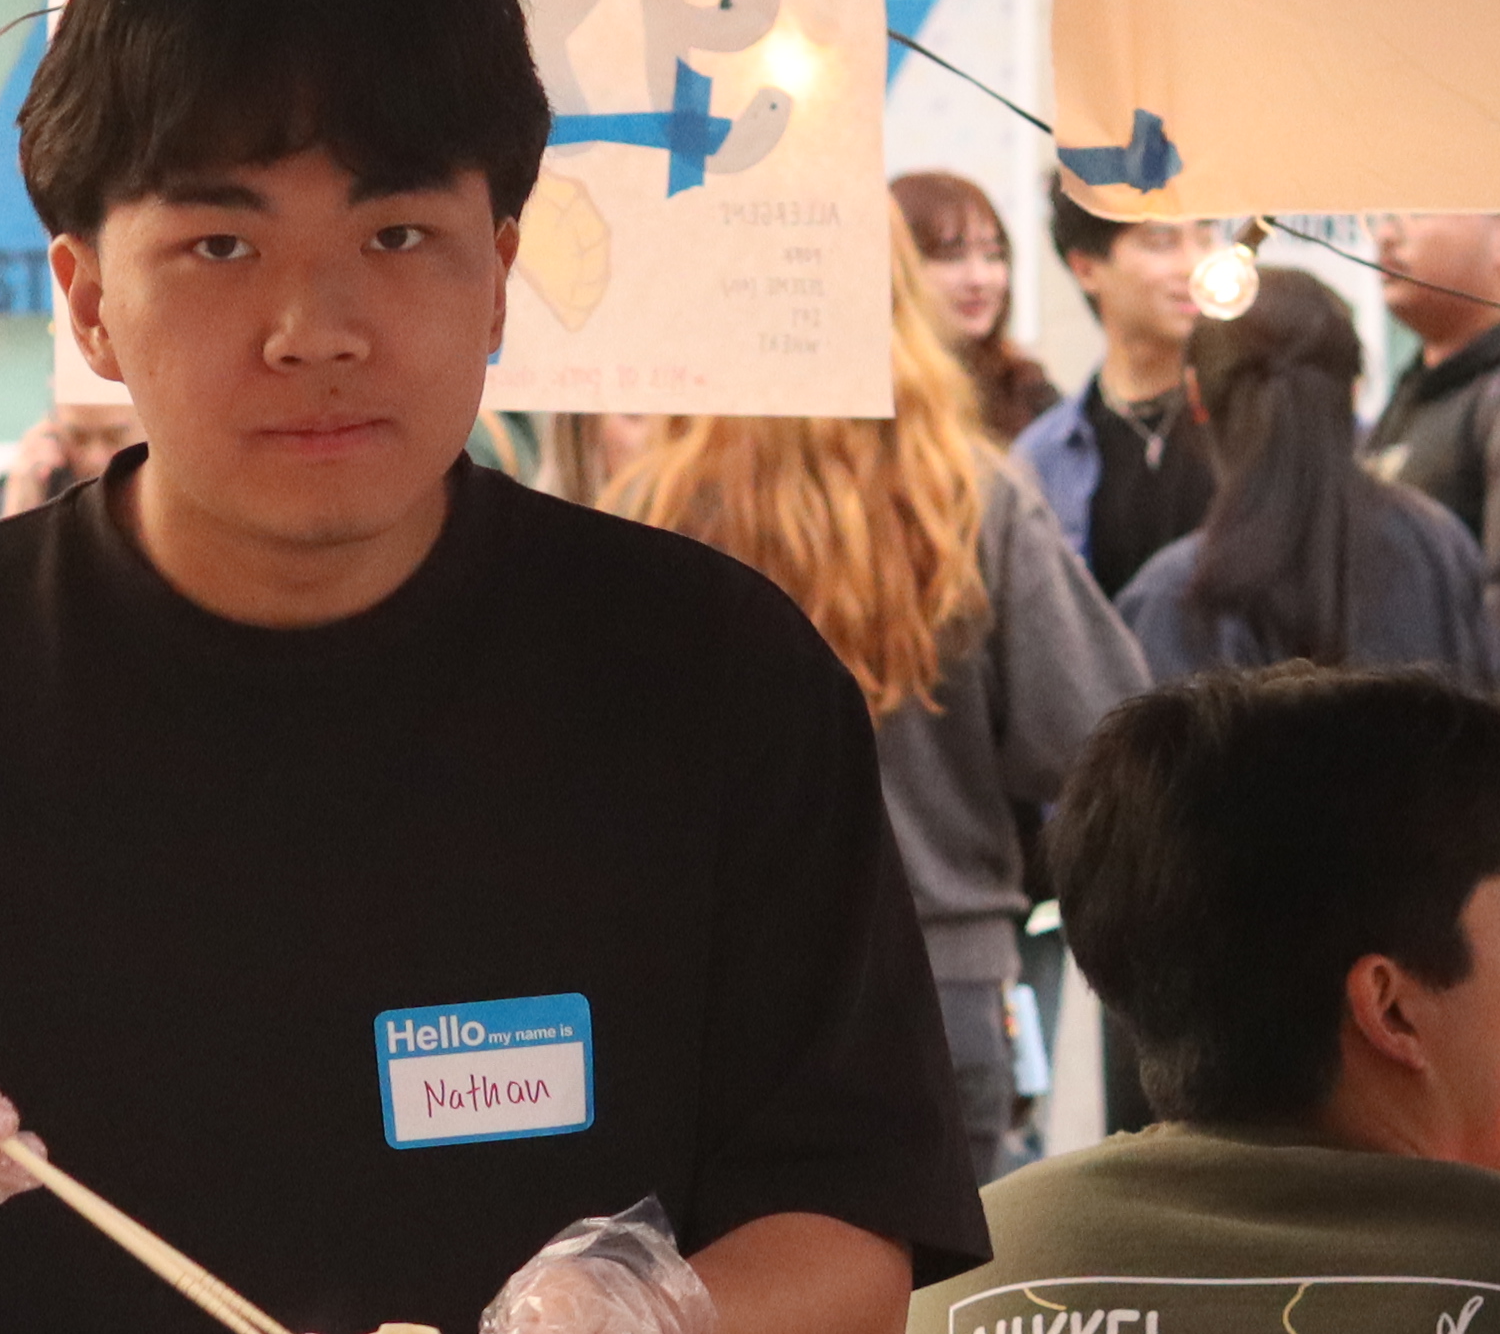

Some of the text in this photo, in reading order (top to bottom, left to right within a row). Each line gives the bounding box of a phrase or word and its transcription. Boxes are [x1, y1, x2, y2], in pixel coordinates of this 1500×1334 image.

[386, 1015, 574, 1054] Hello my name is
[424, 1074, 552, 1118] Nathan
